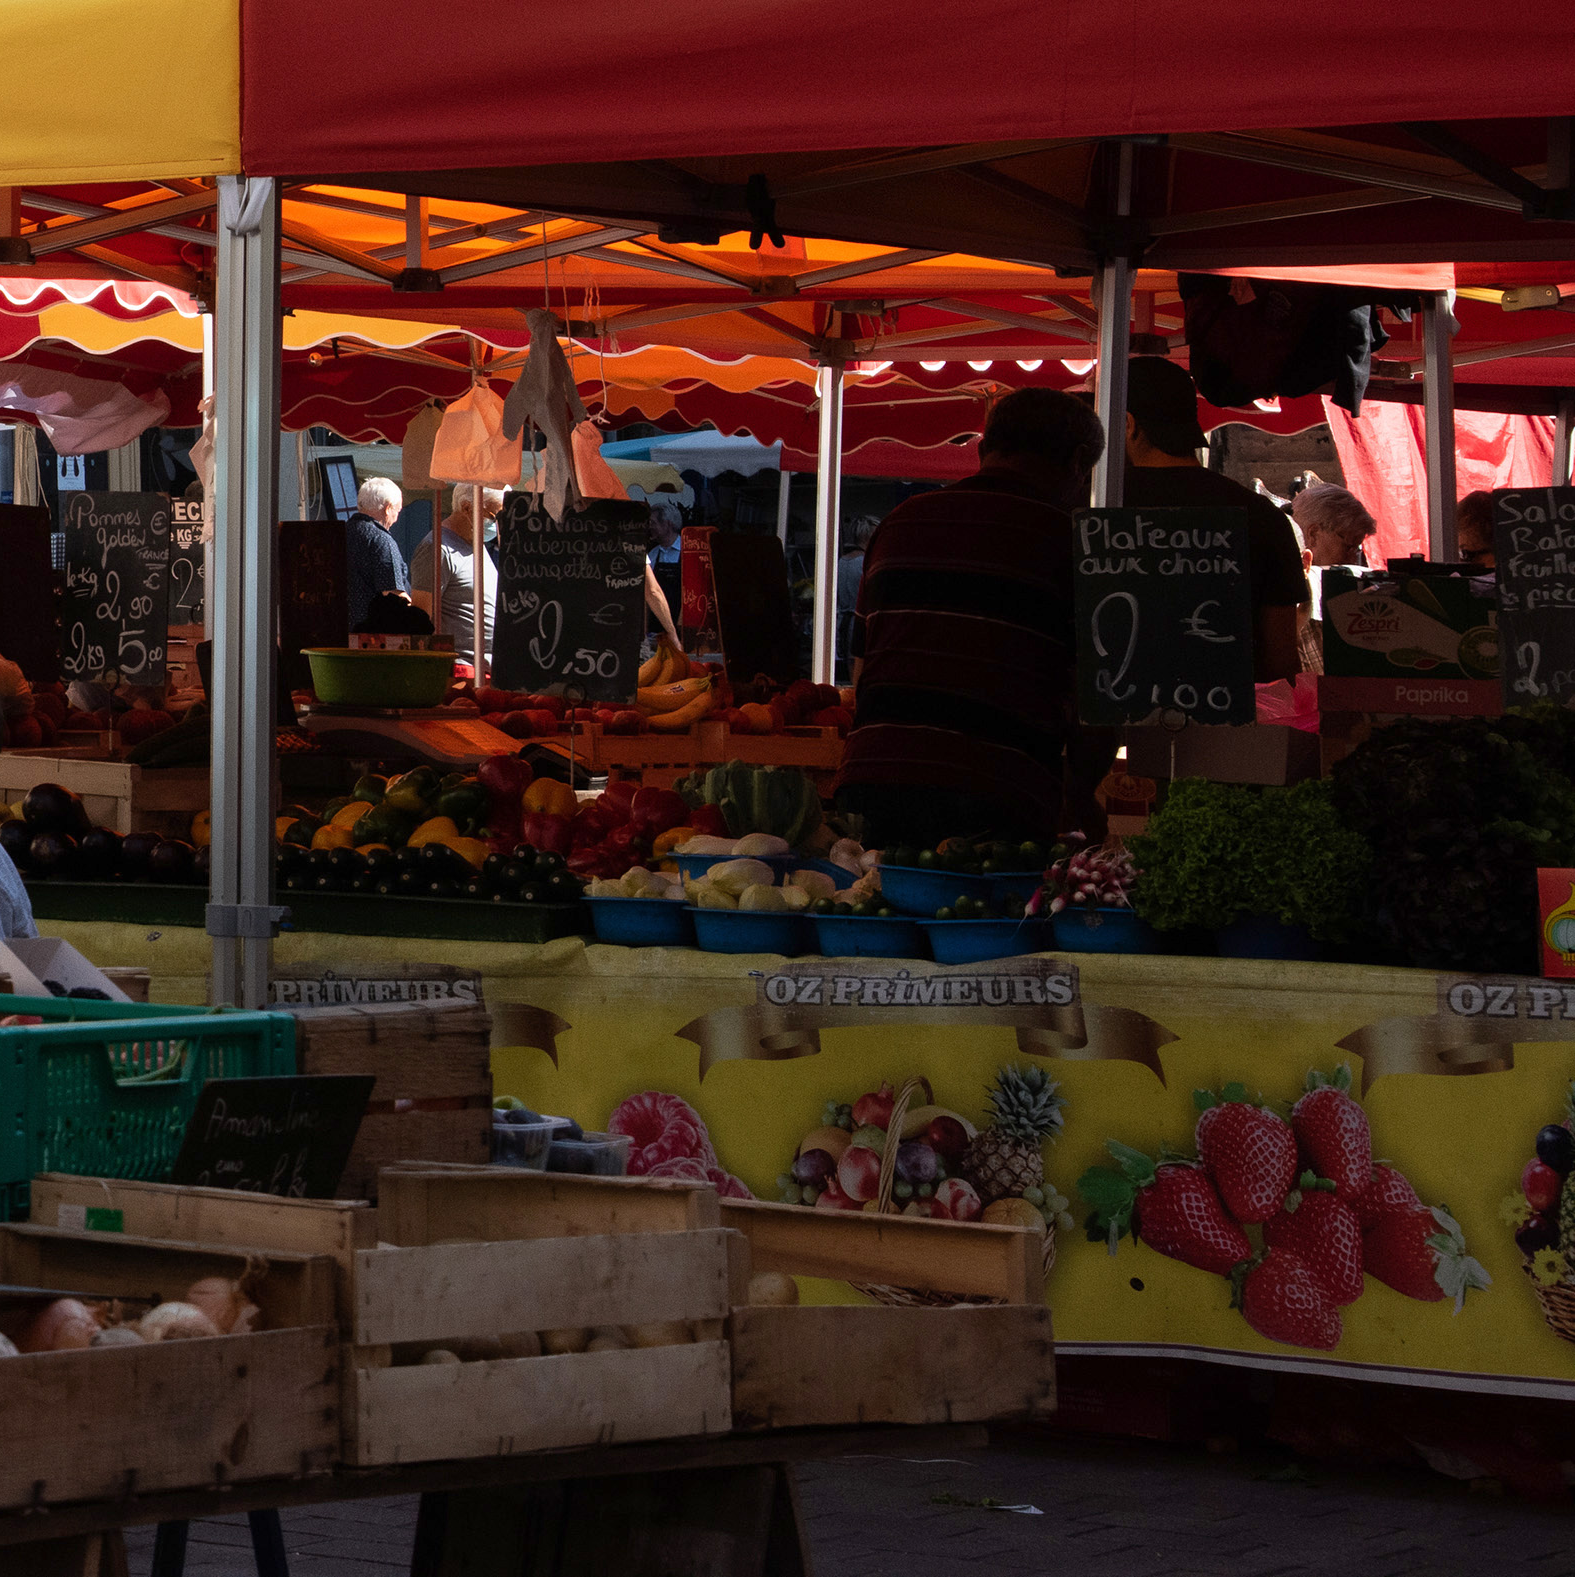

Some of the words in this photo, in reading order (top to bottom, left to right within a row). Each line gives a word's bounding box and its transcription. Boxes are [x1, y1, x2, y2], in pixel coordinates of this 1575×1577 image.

[1079, 515, 1232, 555] Plateaux
[1078, 556, 1150, 575] aux
[1158, 551, 1242, 576] choix
[1347, 612, 1401, 635] Zespri
[1395, 685, 1469, 705] Paprika
[764, 975, 823, 1007] OZ
[1447, 981, 1518, 1017] OZ
